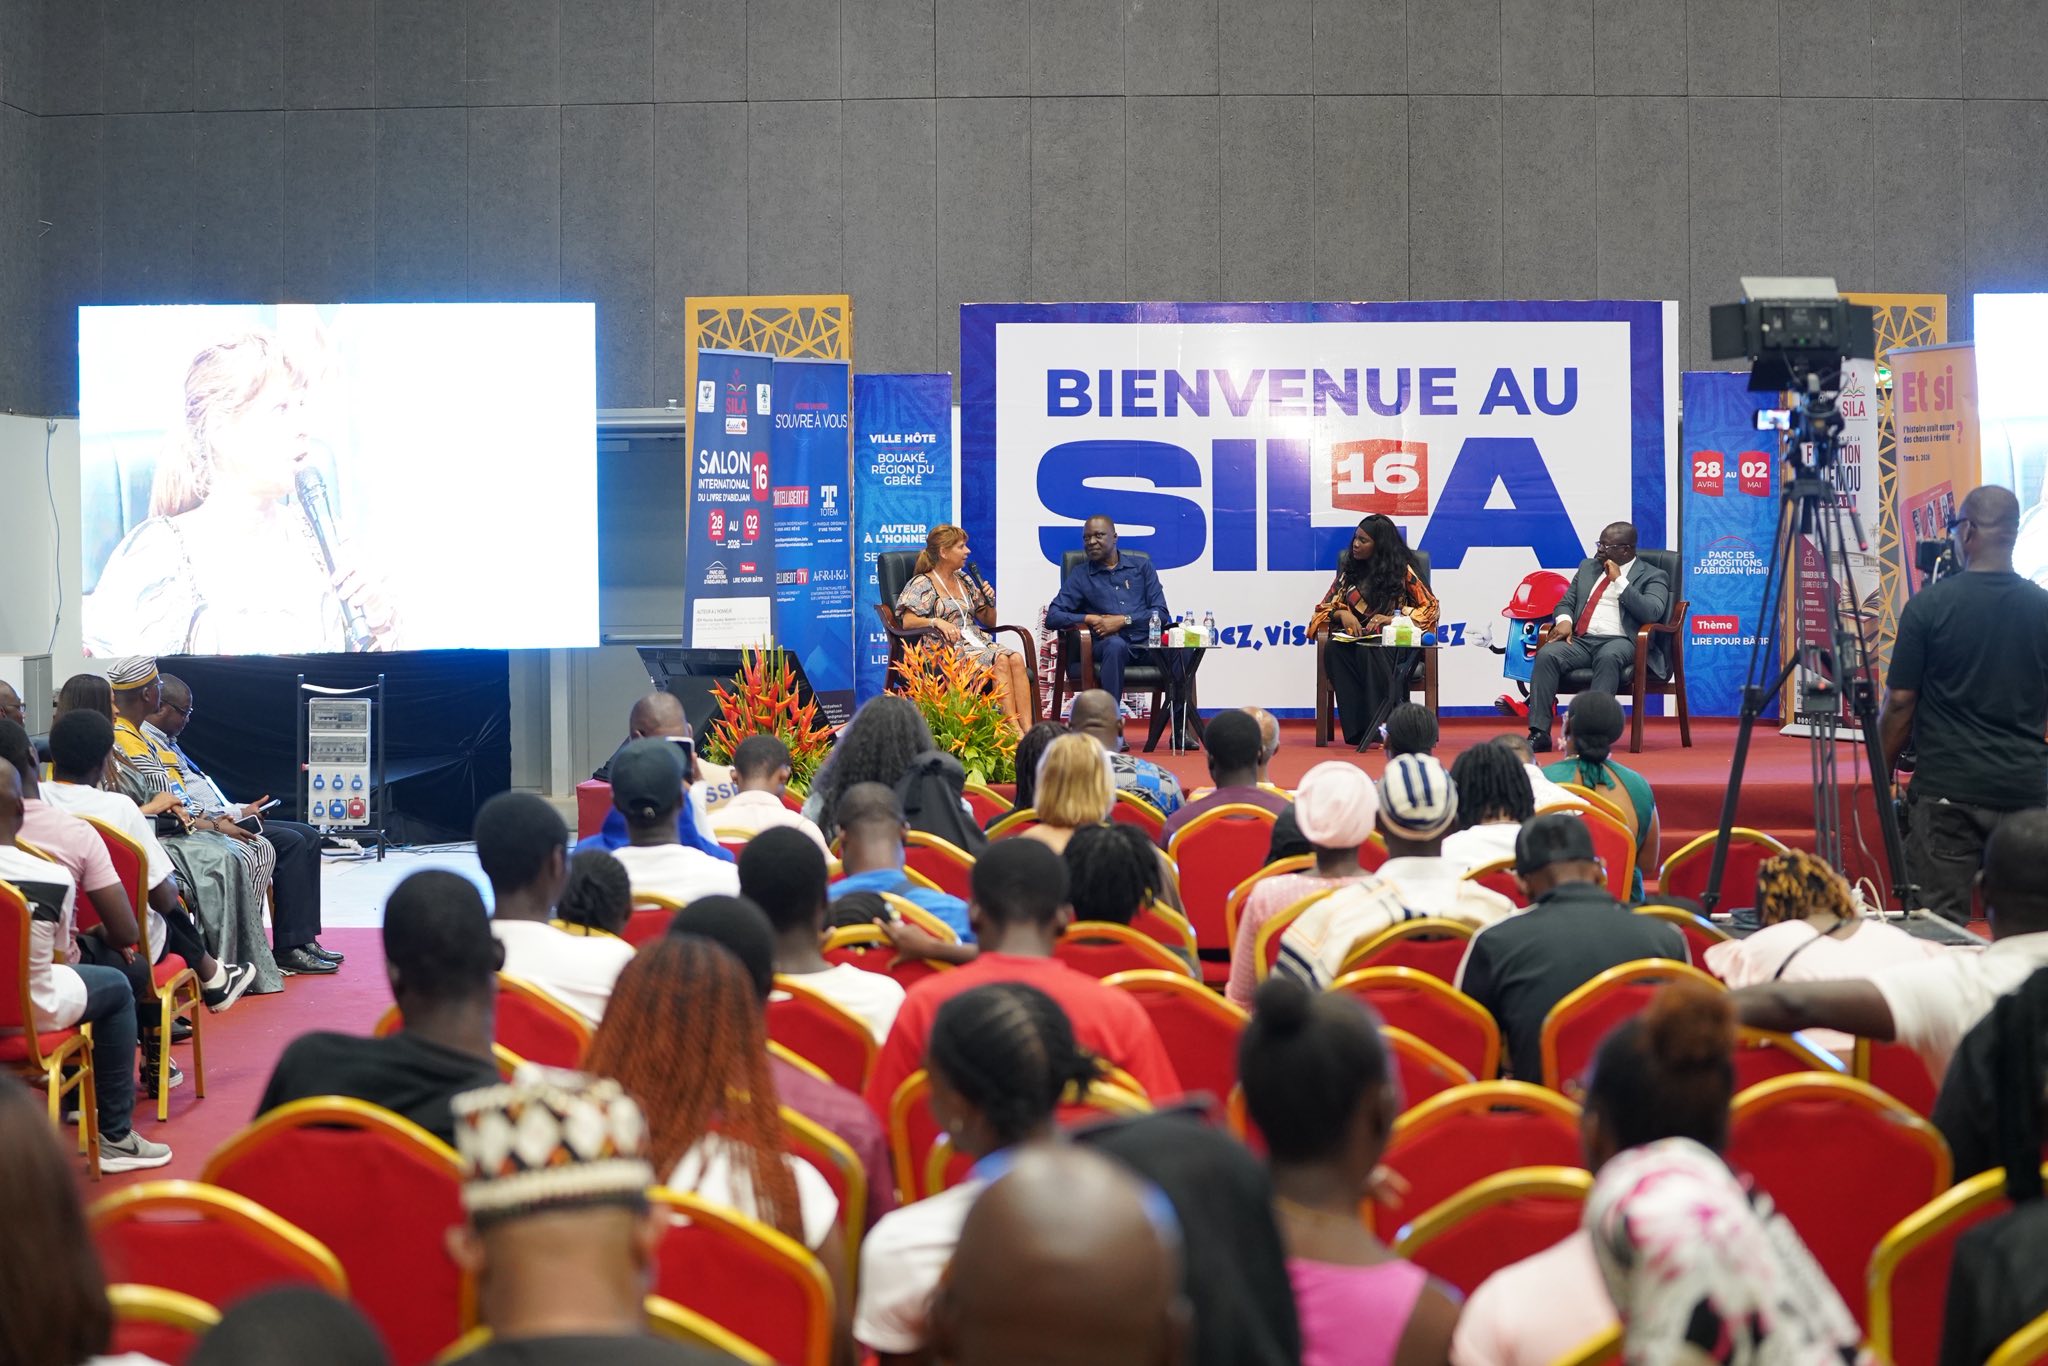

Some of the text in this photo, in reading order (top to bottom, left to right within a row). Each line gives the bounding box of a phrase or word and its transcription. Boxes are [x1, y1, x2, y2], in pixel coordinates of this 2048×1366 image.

[1047, 367, 1578, 417] BIENVENUE AU
[1902, 365, 1953, 413] Et si
[726, 398, 747, 415] SILA
[1842, 400, 1866, 417] SILA
[775, 410, 848, 428] S'OUVRE À VOUS
[869, 432, 936, 443] VILLE HÔTE
[1903, 435, 1913, 443] des
[699, 449, 751, 475] SALON
[877, 452, 928, 464] BOUAKÉ,
[871, 463, 935, 474] RÉGION DU
[1337, 453, 1420, 495] 16
[1694, 461, 1721, 478] 28
[1741, 461, 1768, 478] 02
[753, 463, 768, 490] 16
[698, 479, 750, 490] INTERNATIONAL
[698, 493, 750, 502] DU LIVRE D'ABIDJAN
[1036, 437, 1588, 572] SILA
[820, 508, 838, 517] TOTEM
[711, 515, 758, 531] 28 AU 02
[880, 524, 927, 534] AUTEUR
[863, 532, 929, 544] À L'HONNE
[1708, 551, 1755, 559] PARC DES
[1701, 559, 1763, 567] EXPOSITIONS
[1693, 567, 1770, 576] D'ABIDJAN (Hall)
[1697, 620, 1733, 630] Thème
[1691, 635, 1770, 646] LIRE POUR BÂIR
